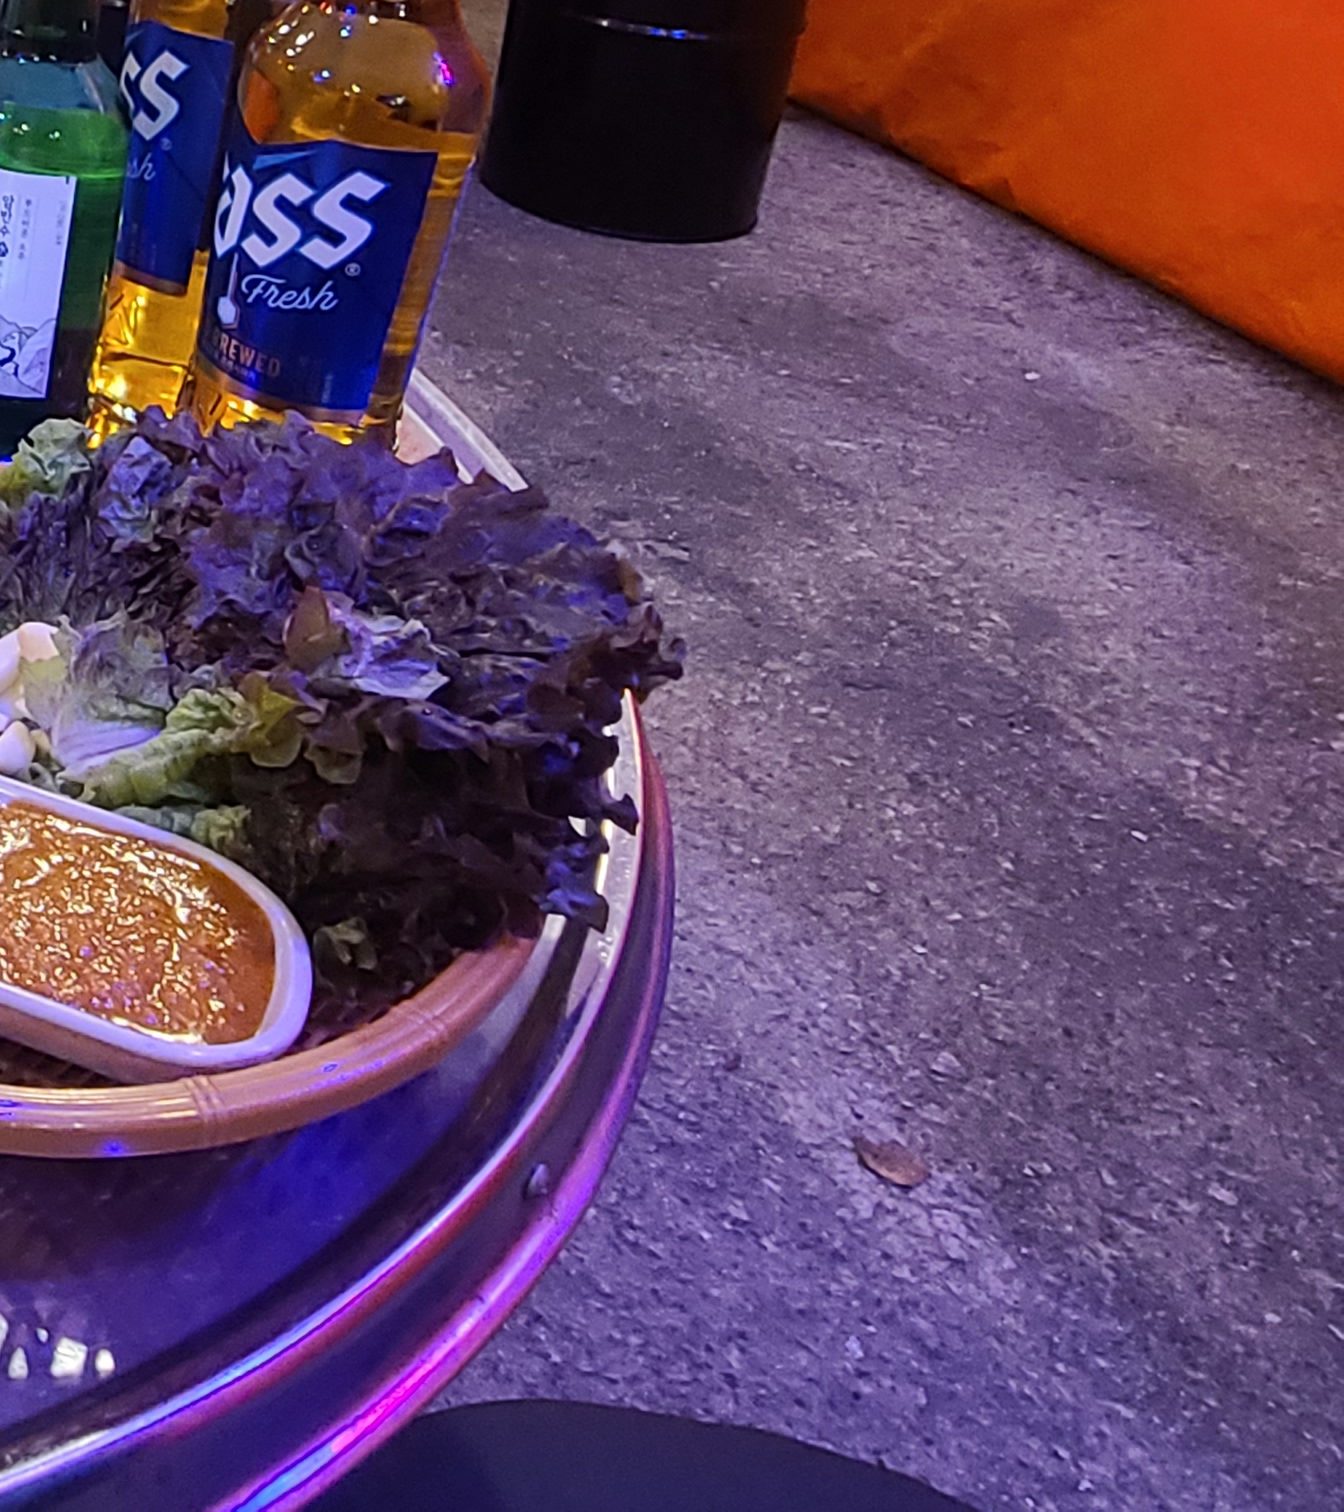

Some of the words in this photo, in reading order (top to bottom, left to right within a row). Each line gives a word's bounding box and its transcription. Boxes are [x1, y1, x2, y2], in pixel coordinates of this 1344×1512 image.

[214, 163, 390, 270] ASS
[241, 274, 339, 311] Fresh
[214, 331, 281, 377] REWED
